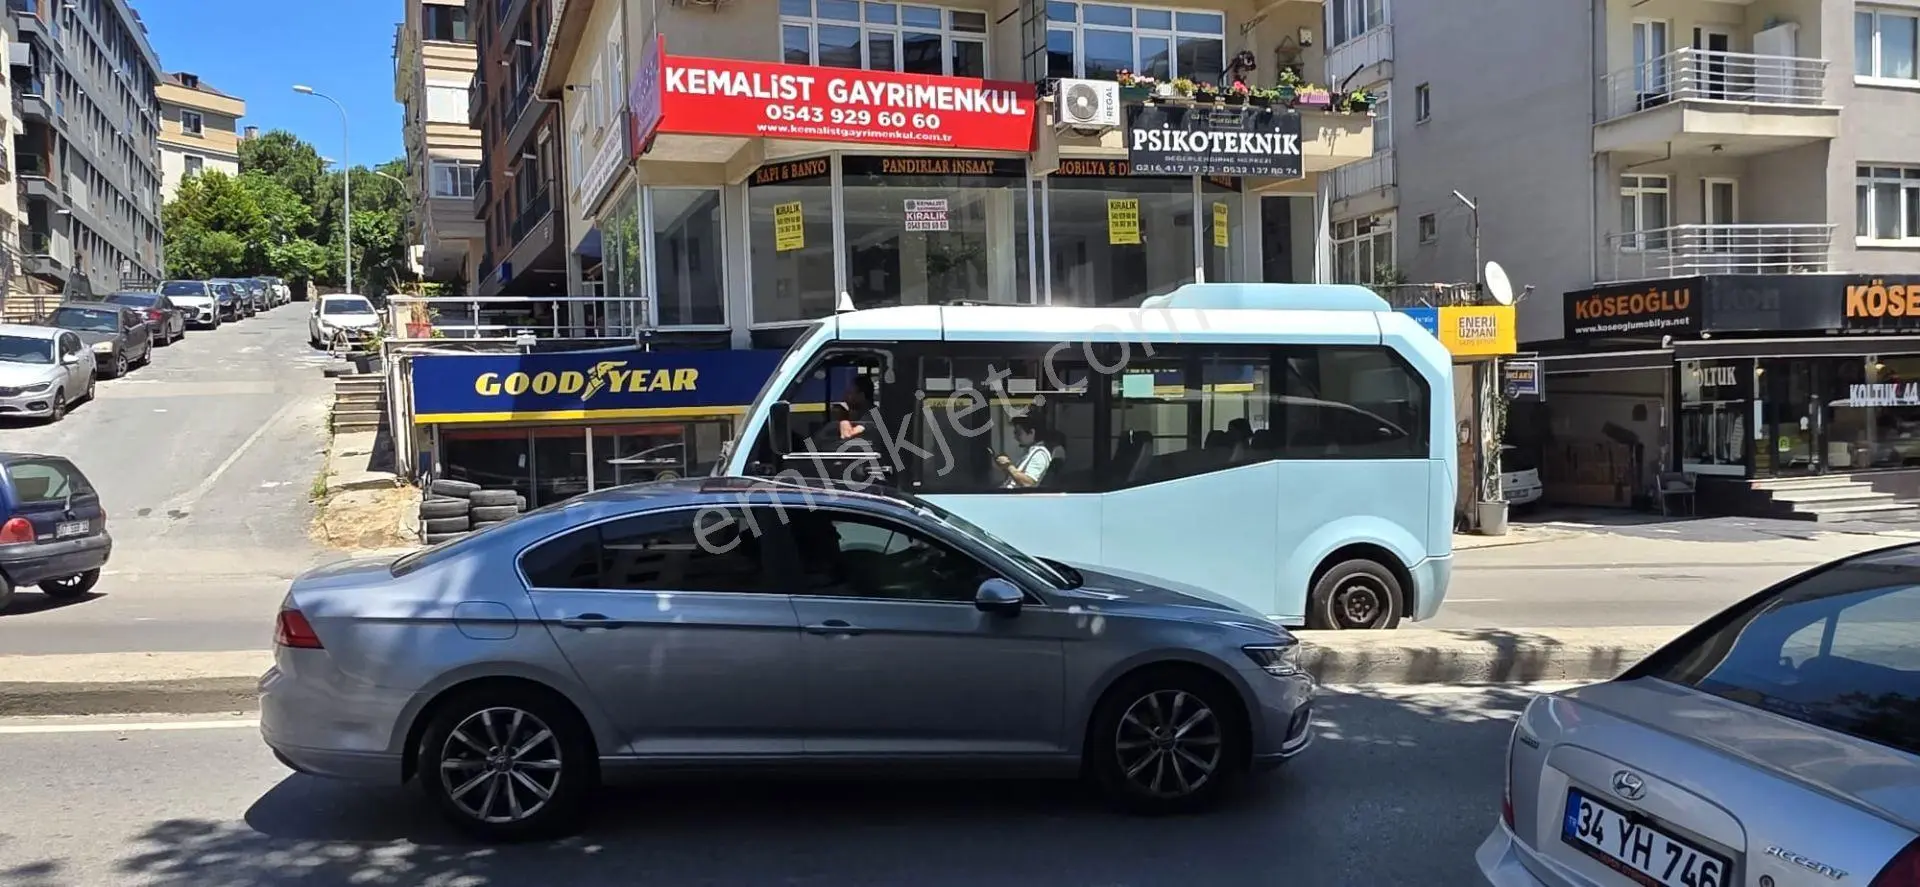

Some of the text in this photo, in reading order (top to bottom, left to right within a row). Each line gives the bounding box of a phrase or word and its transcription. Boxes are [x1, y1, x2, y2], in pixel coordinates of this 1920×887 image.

[1105, 87, 1113, 117] REGAL
[766, 104, 941, 129] 0543 929 60 60
[757, 124, 953, 141] www.kemalistgayrimenkul.com.tr
[1133, 122, 1300, 155] PSİKOTEKNİK
[791, 160, 827, 178] BANYO
[882, 159, 950, 173] PANDIRLAR
[1165, 164, 1184, 173] 417
[1188, 165, 1199, 173] 17
[1575, 287, 1690, 320] KÖSEOĞLU
[1458, 314, 1496, 327] ENERJİ
[1458, 327, 1496, 338] UZMANI
[1850, 383, 1898, 407] KOLTUK
[1577, 802, 1604, 844] 34
[1619, 819, 1654, 870] YH
[1662, 841, 1720, 887] 746
